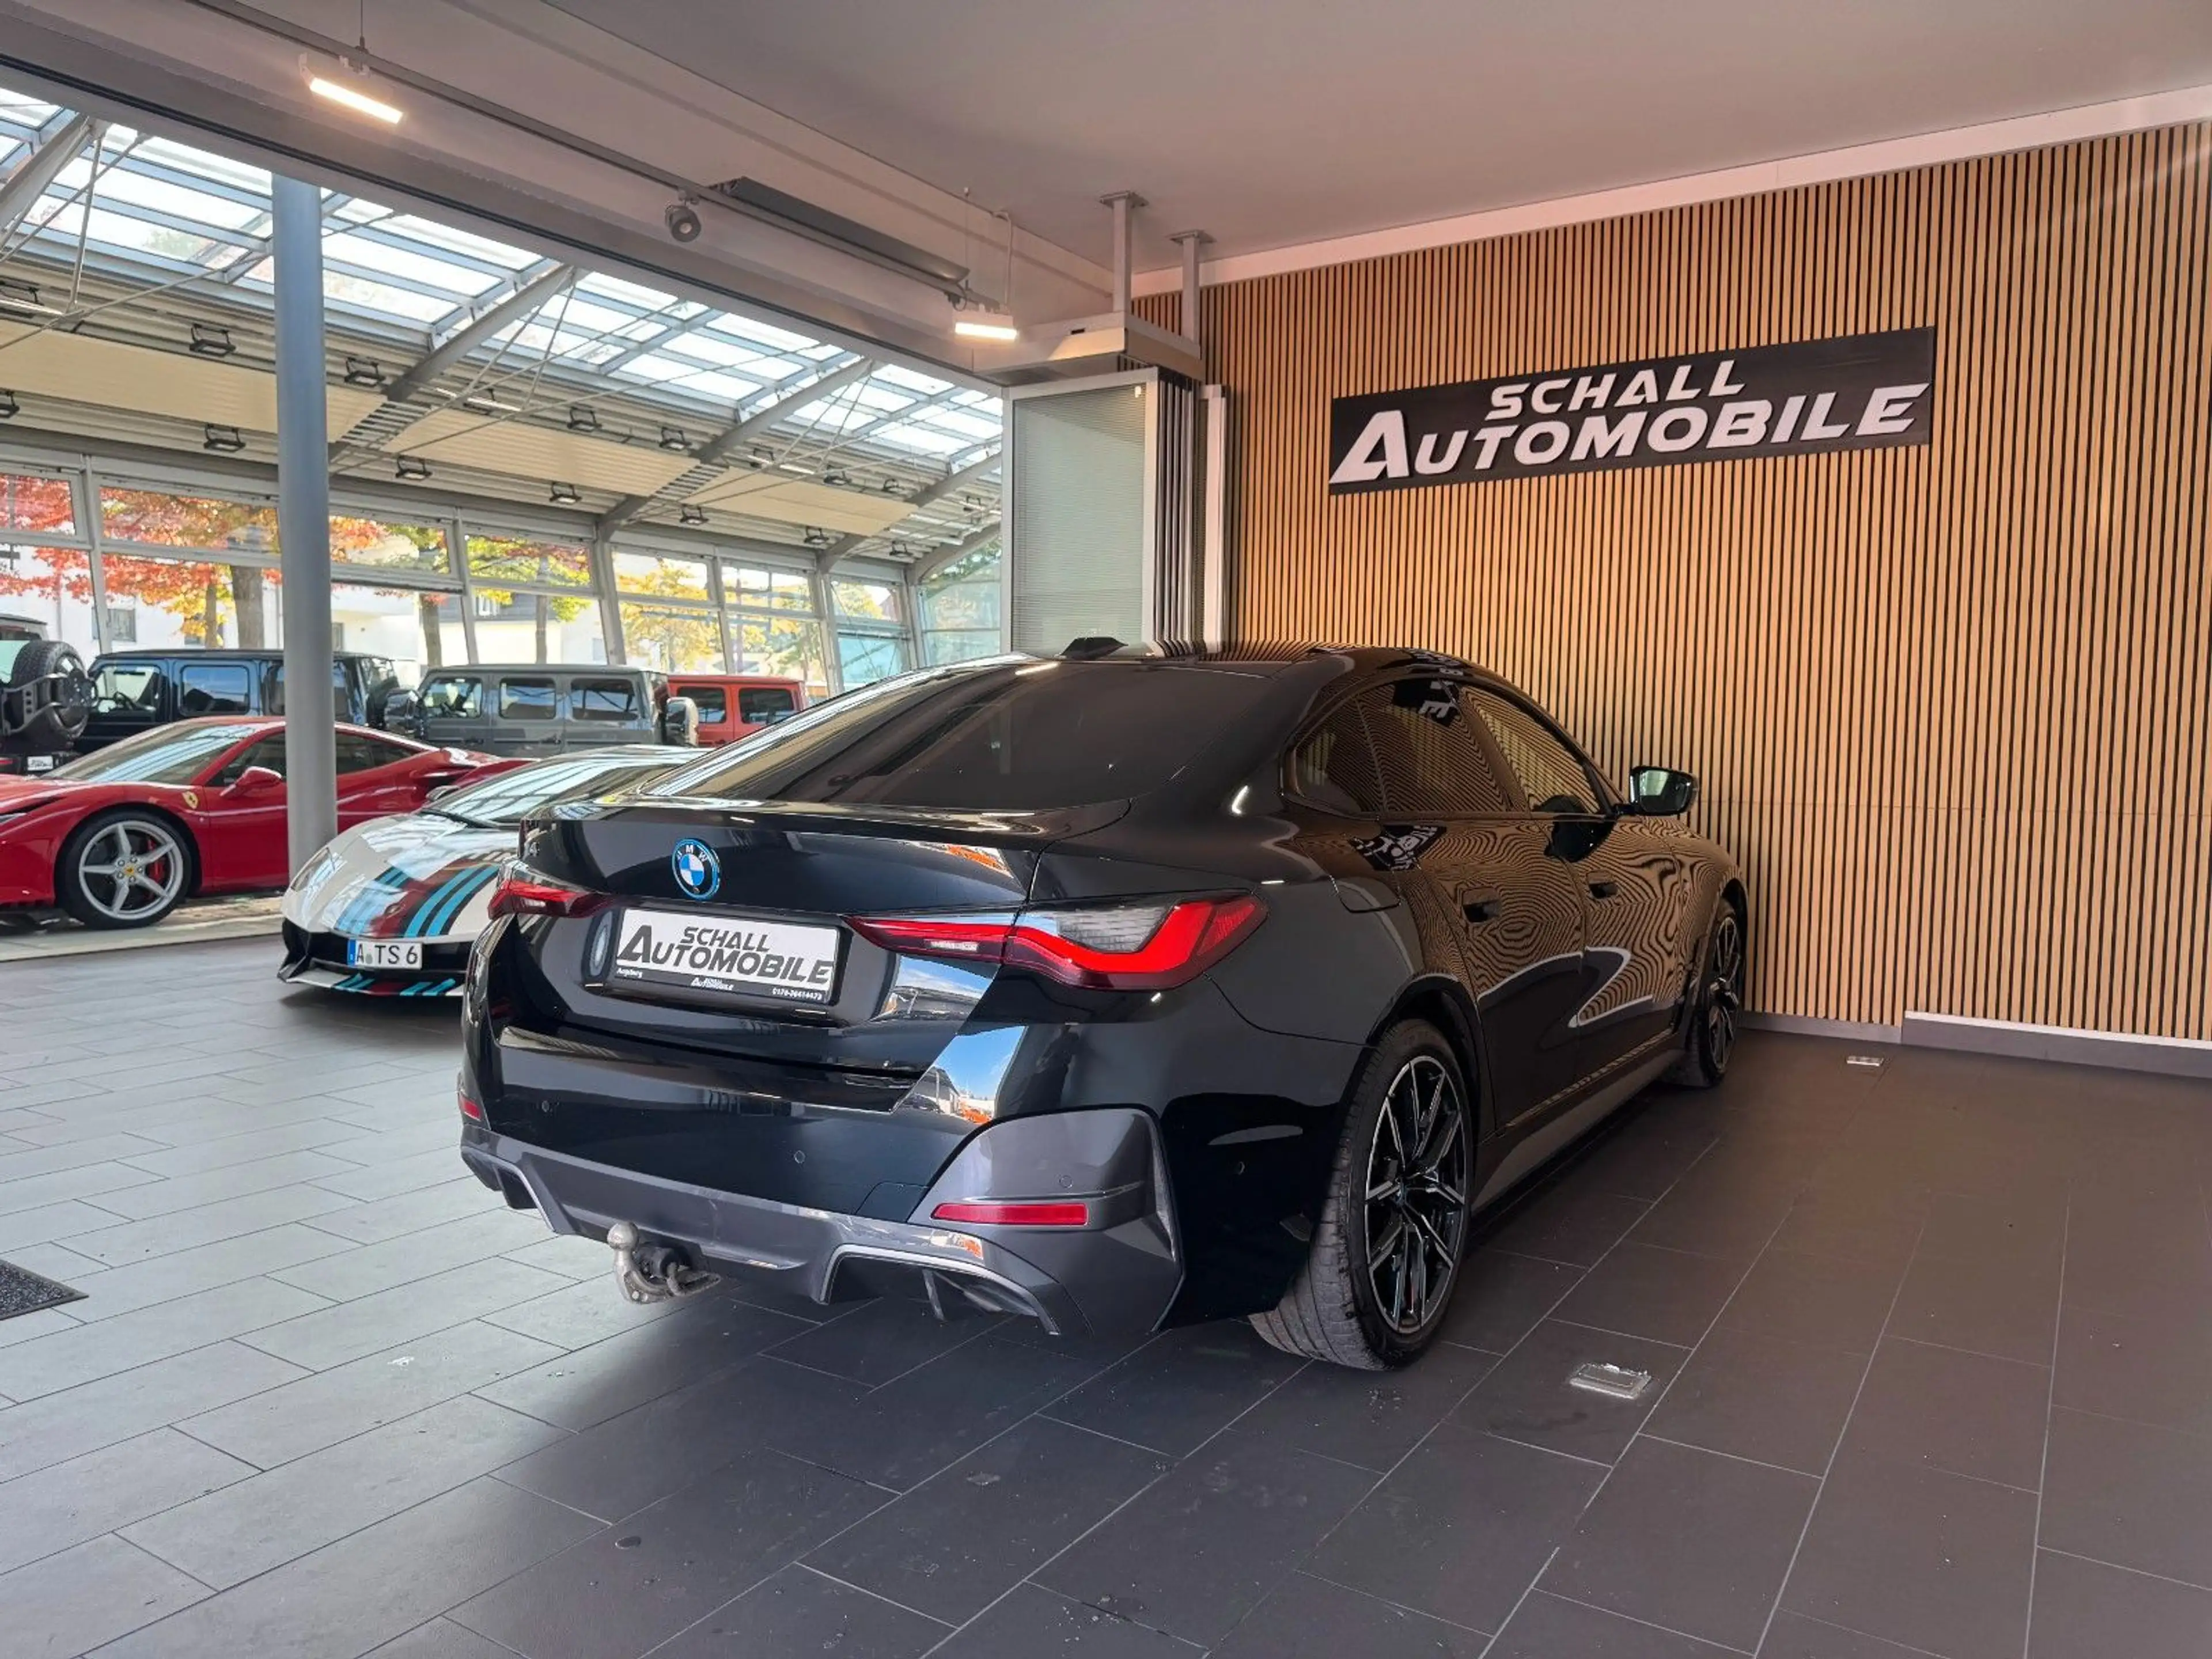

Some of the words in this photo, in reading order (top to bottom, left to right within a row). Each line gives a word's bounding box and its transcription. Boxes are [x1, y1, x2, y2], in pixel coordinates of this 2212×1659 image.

[1485, 359, 1745, 421] SCHALL
[1329, 383, 1930, 484] AUTOMOBILE
[357, 943, 365, 964] A
[374, 944, 400, 964] TS
[406, 945, 418, 964] 6
[616, 925, 833, 984] AUTOMOBILE
[680, 926, 770, 952] SCHALL
